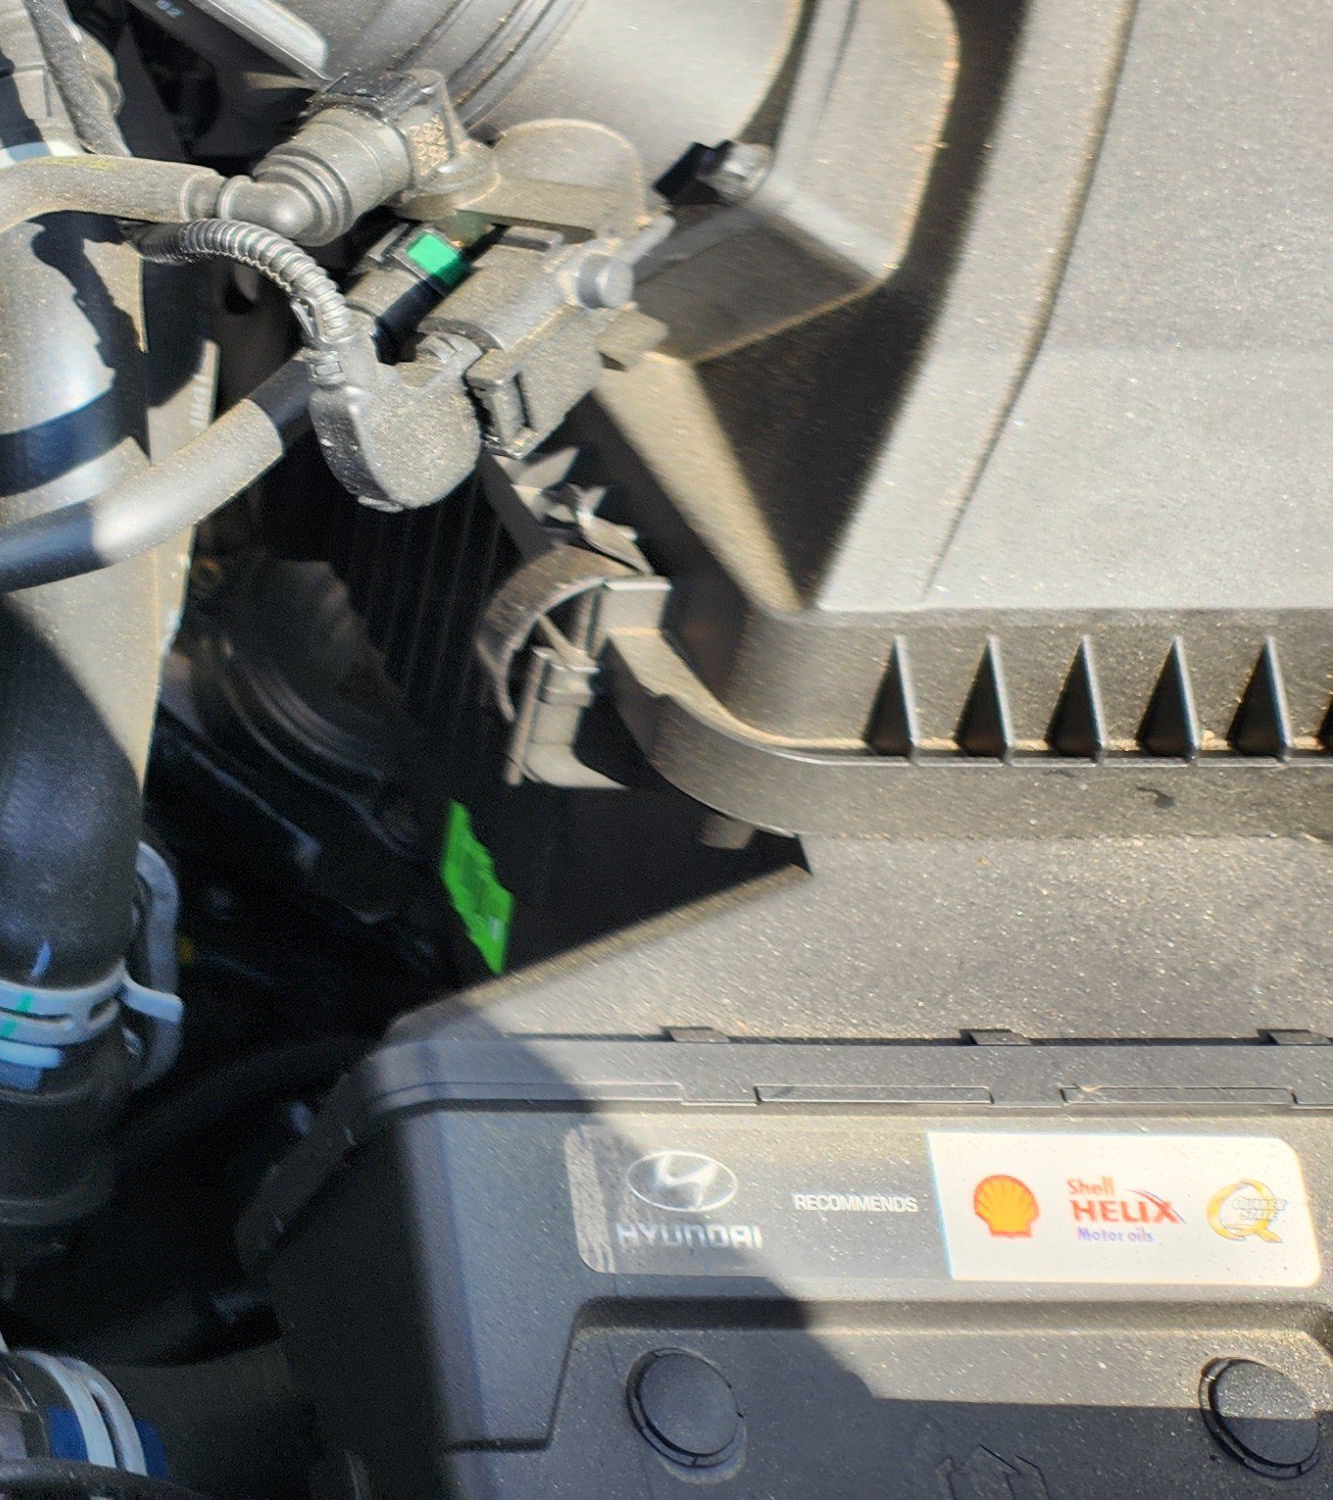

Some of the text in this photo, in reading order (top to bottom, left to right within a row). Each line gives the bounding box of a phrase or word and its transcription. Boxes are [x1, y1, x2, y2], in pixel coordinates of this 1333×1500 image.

[1067, 1176, 1114, 1196] Shell
[793, 1193, 919, 1214] RECOMMENDS
[1070, 1198, 1182, 1224] HELIX
[616, 1223, 1155, 1250] HYUNDAI Motor oils
